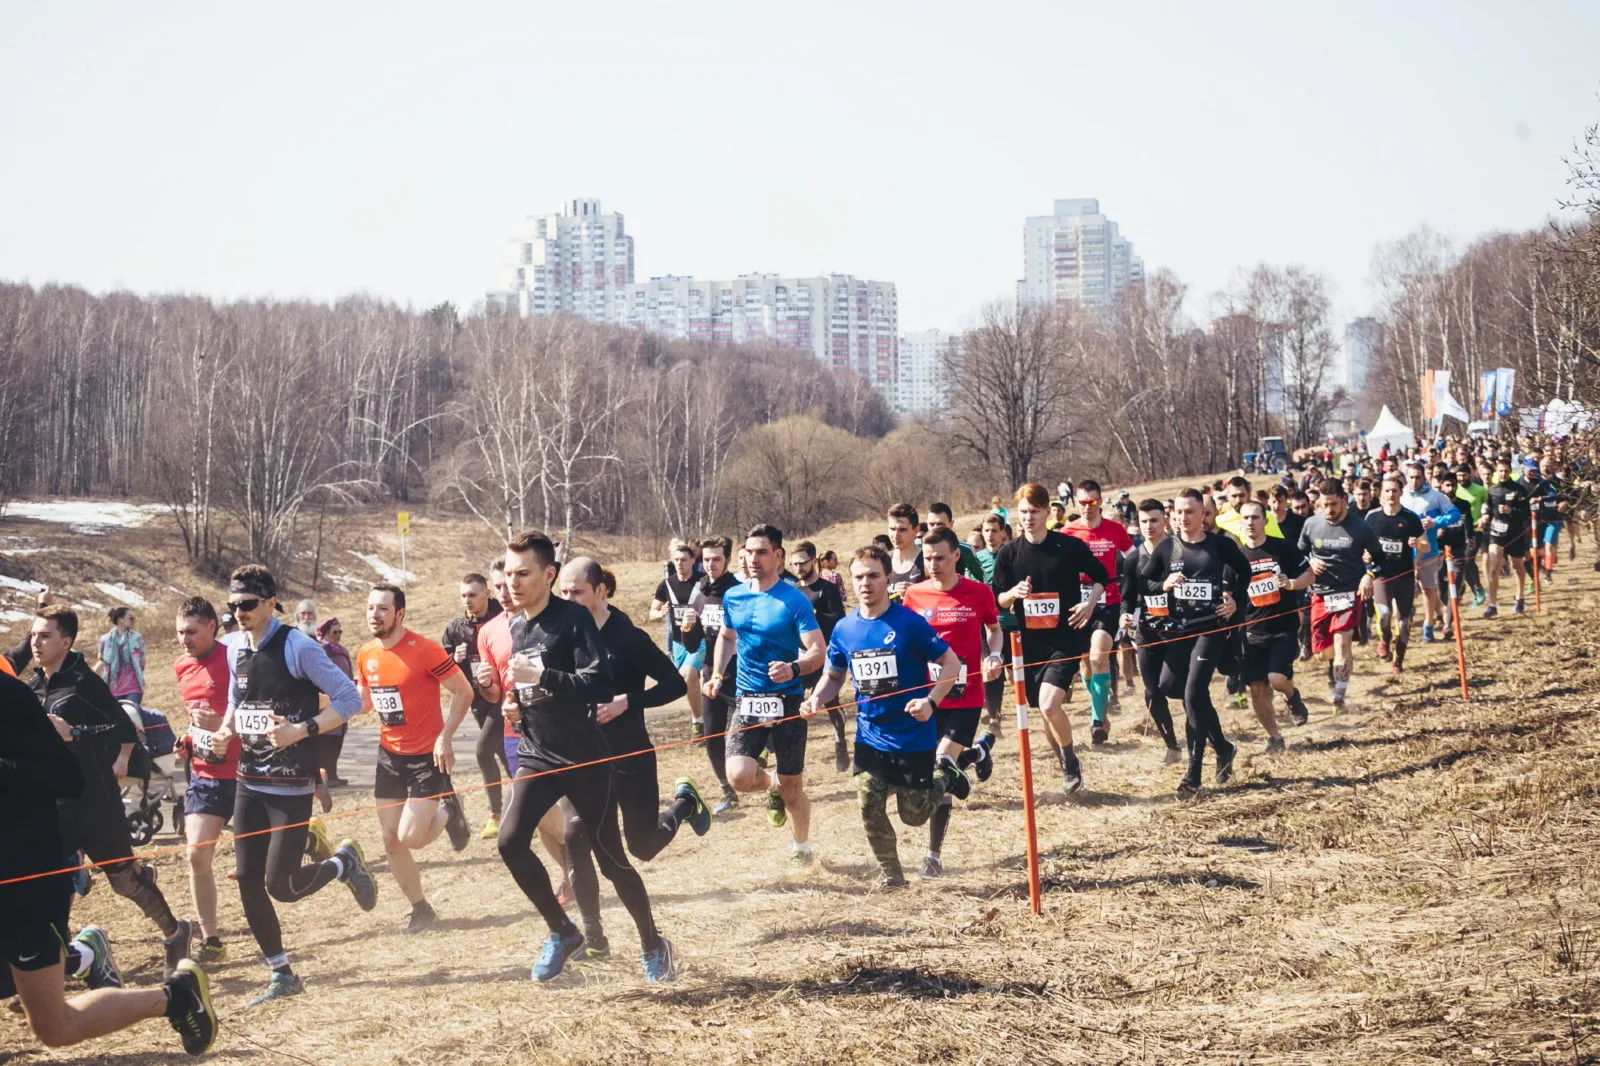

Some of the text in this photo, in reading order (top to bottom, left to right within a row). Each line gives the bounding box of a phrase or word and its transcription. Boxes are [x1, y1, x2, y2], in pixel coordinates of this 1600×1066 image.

[1179, 586, 1207, 598] 1625
[1250, 581, 1274, 594] 1120
[1149, 596, 1167, 606] 113
[1027, 602, 1055, 614] 1139
[858, 661, 890, 676] 1391
[748, 701, 778, 714] 1303
[239, 715, 269, 731] 1459
